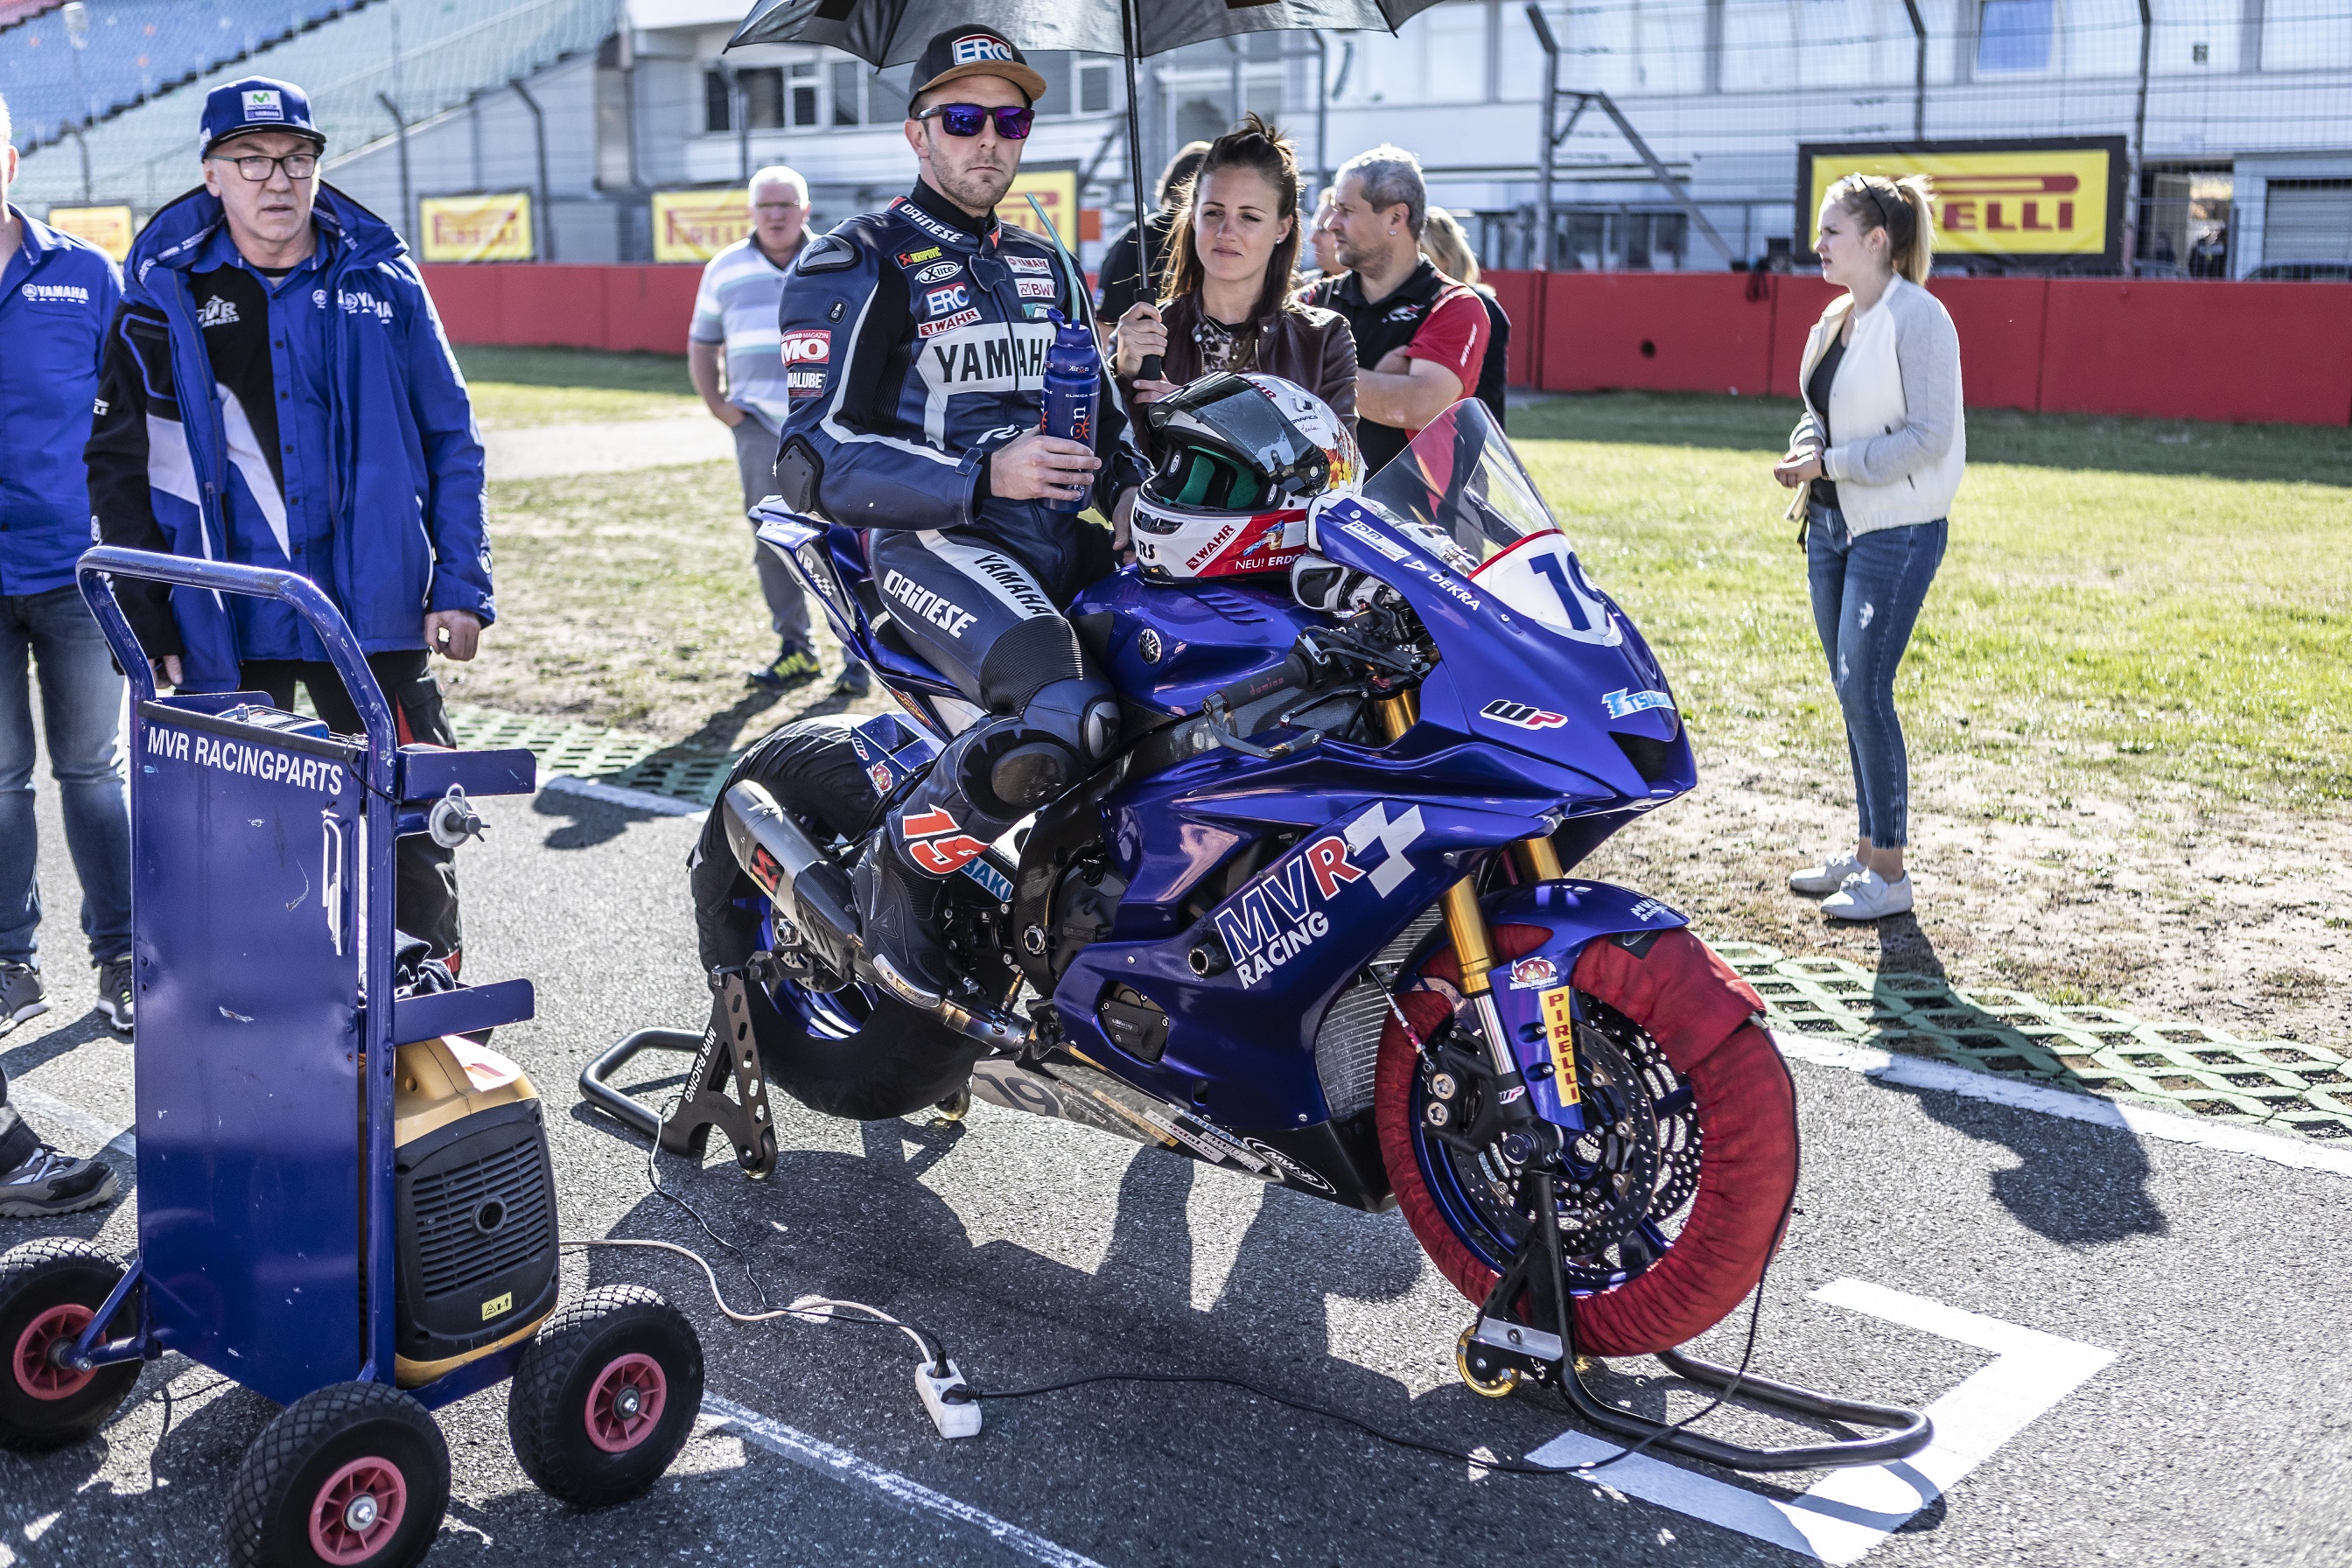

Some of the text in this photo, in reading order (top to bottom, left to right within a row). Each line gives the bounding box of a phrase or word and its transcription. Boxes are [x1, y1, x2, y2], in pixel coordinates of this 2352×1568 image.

[956, 38, 1012, 63] ERC
[38, 285, 88, 300] YAMAHA
[927, 285, 970, 316] ERC
[935, 310, 978, 332] WAHR
[1195, 524, 1235, 560] WAHR
[1235, 557, 1265, 570] NEU!
[973, 554, 1054, 616] YAMAHA
[1427, 572, 1481, 612] DEKRA
[147, 725, 343, 795] MVR RACINGPARTS
[961, 855, 1013, 903] BAKI
[1214, 836, 1367, 967] MVR
[1236, 912, 1329, 990] RACING
[684, 1026, 718, 1103] MVR RACING
[1548, 993, 1578, 1100] PIRELLI
